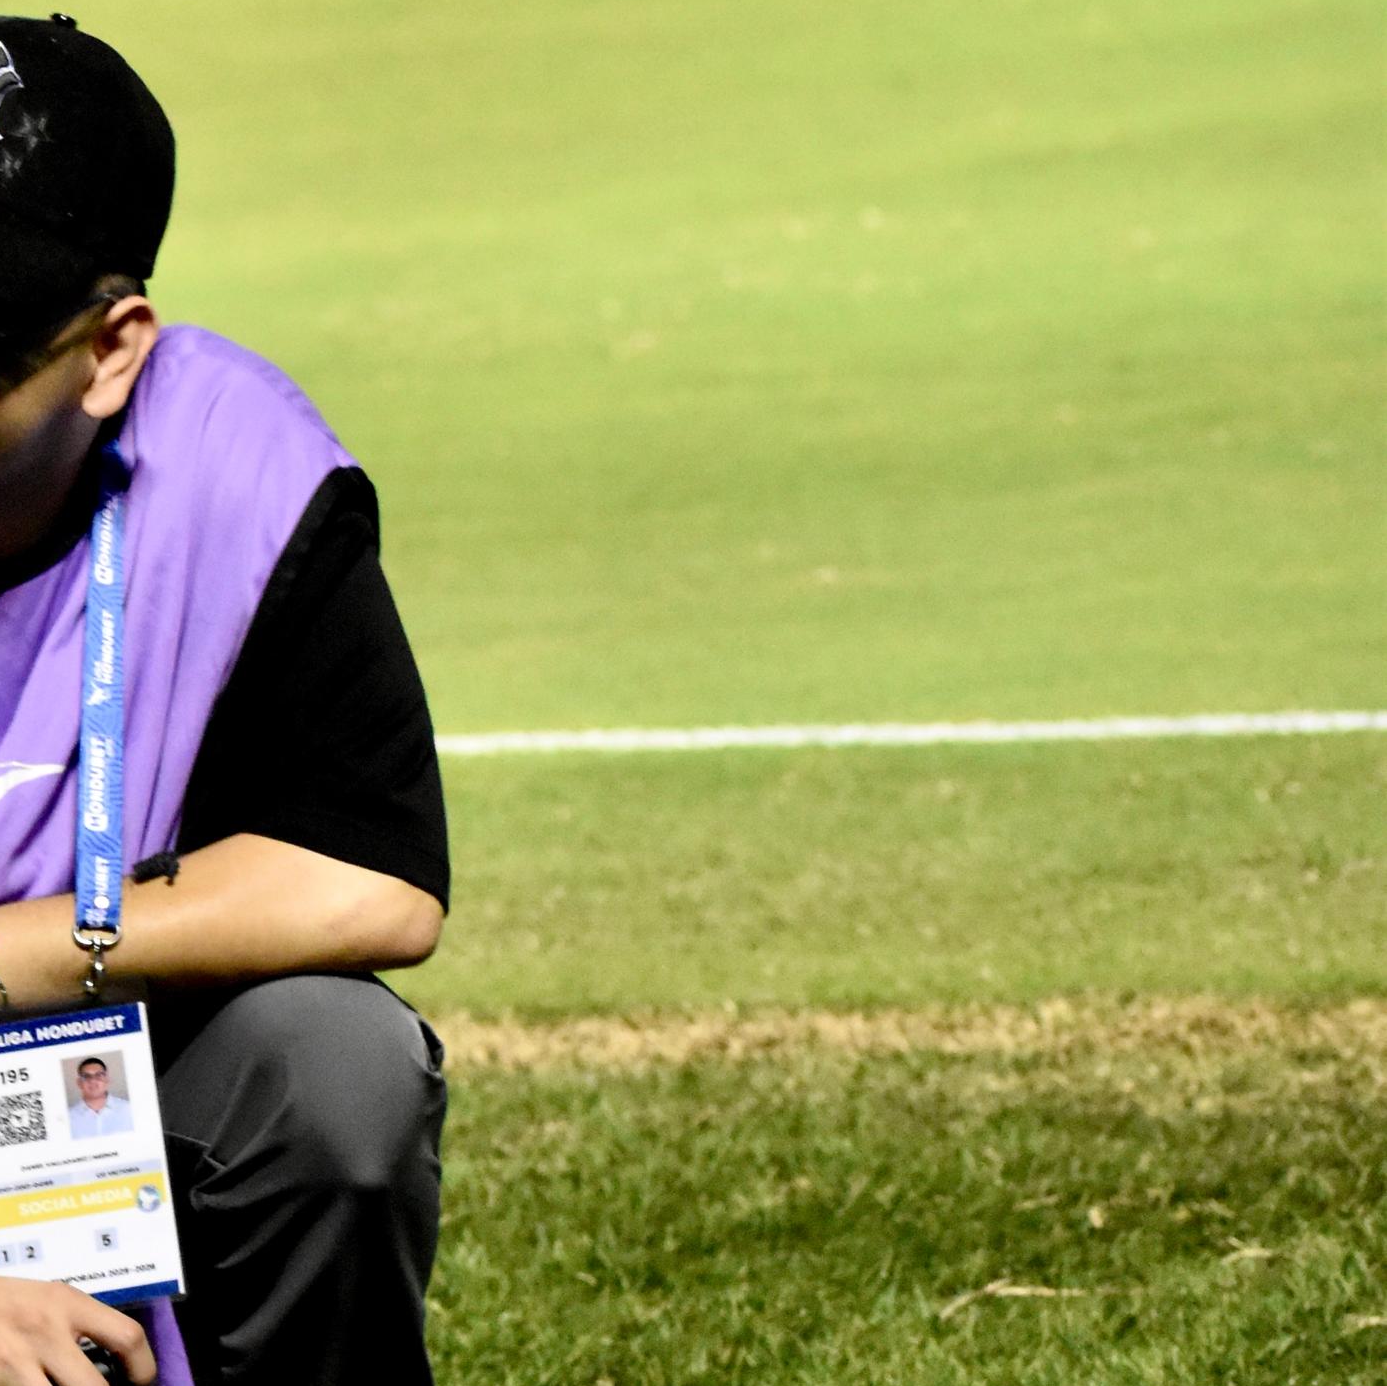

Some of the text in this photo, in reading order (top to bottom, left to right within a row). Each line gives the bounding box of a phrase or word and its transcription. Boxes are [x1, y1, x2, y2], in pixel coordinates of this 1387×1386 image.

[84, 737, 108, 832] HONDUBET
[0, 1068, 30, 1085] 195
[17, 1194, 78, 1217] SOCIAL
[81, 1185, 133, 1208] MEDIA
[2, 1233, 112, 1263] 1 2 5
